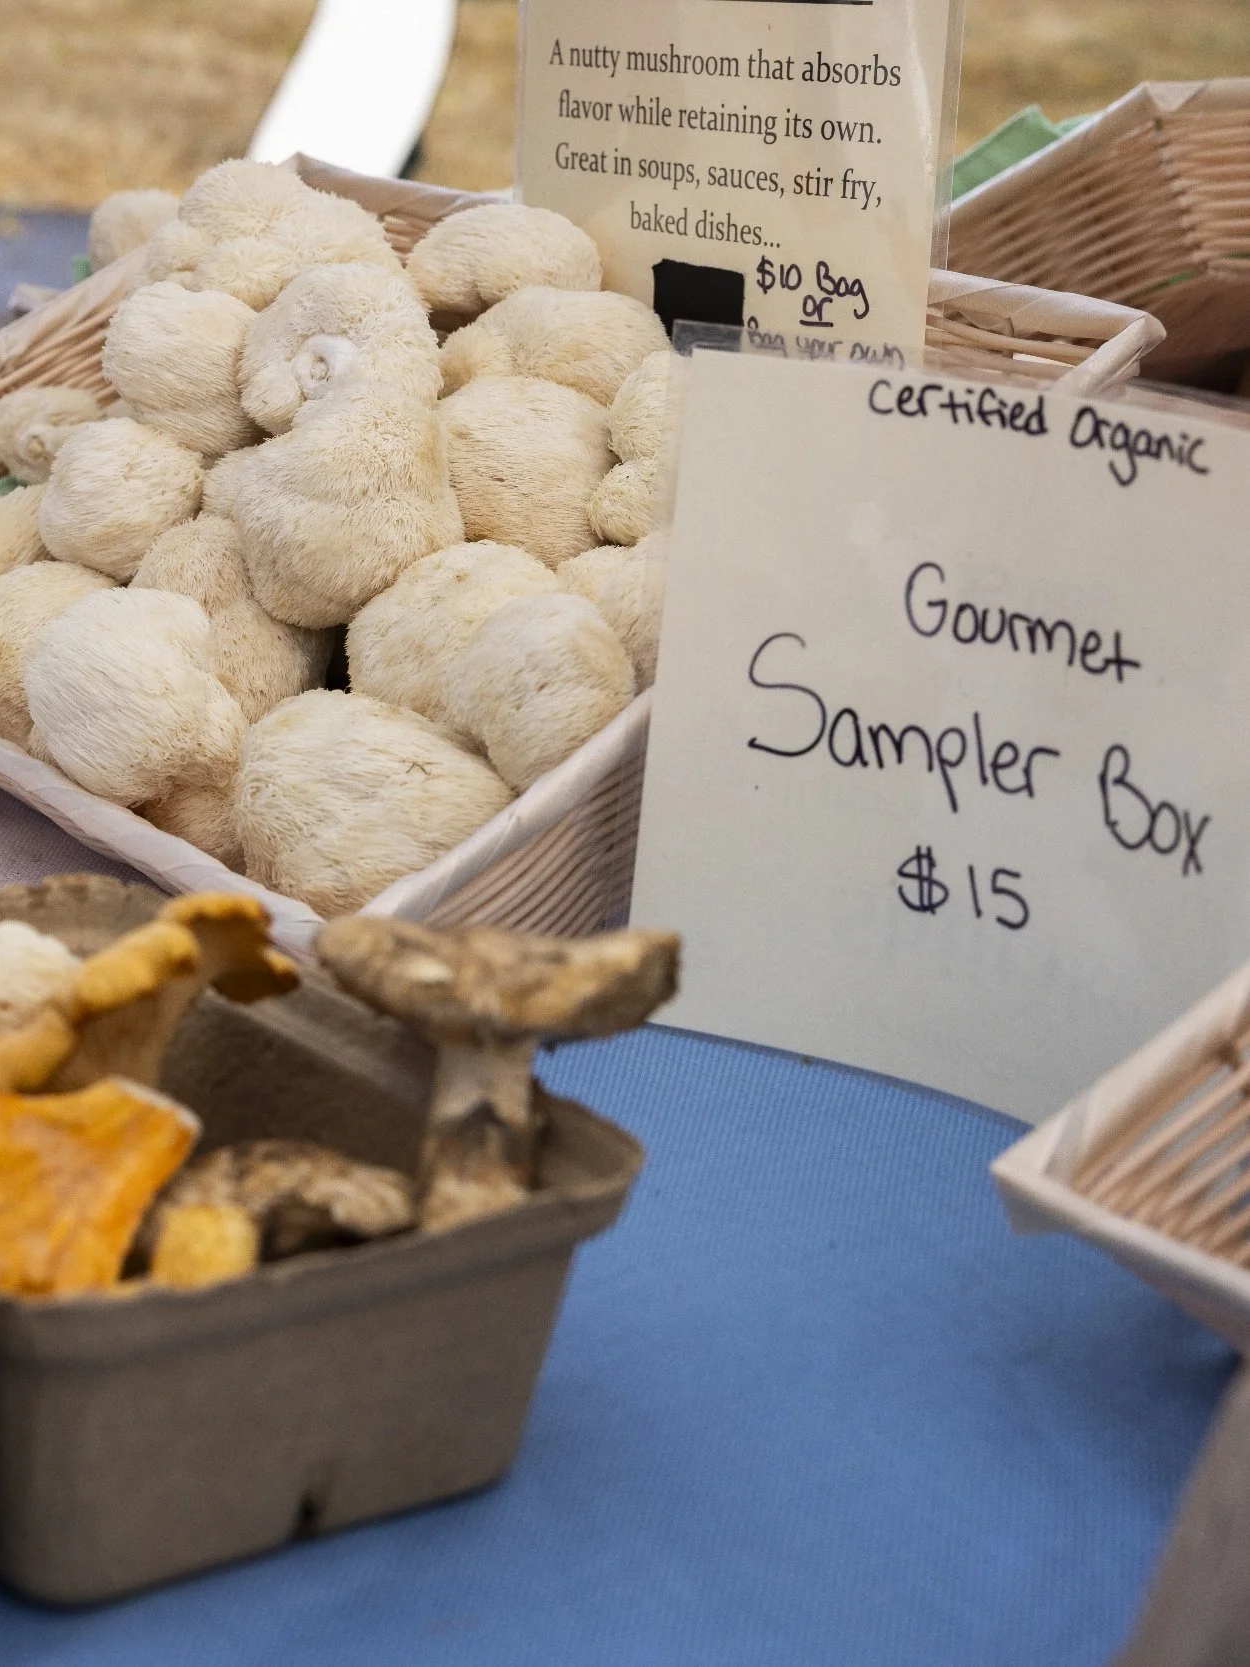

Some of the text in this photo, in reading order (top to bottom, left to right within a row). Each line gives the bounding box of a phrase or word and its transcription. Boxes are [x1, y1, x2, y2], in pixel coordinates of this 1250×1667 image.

[549, 38, 902, 87] A nutty mushroom that absorbs
[558, 88, 882, 145] flavor while retaining its own.
[555, 142, 882, 211] Great in soups, sauces, stir fry,
[630, 200, 781, 249] baked dishes...
[756, 255, 870, 320] $10 Bag
[802, 294, 833, 322] or
[1069, 405, 1211, 487] Organic
[904, 562, 1141, 683] Gourmet
[748, 632, 1211, 876] Sampler Box
[897, 845, 1029, 930] $15
